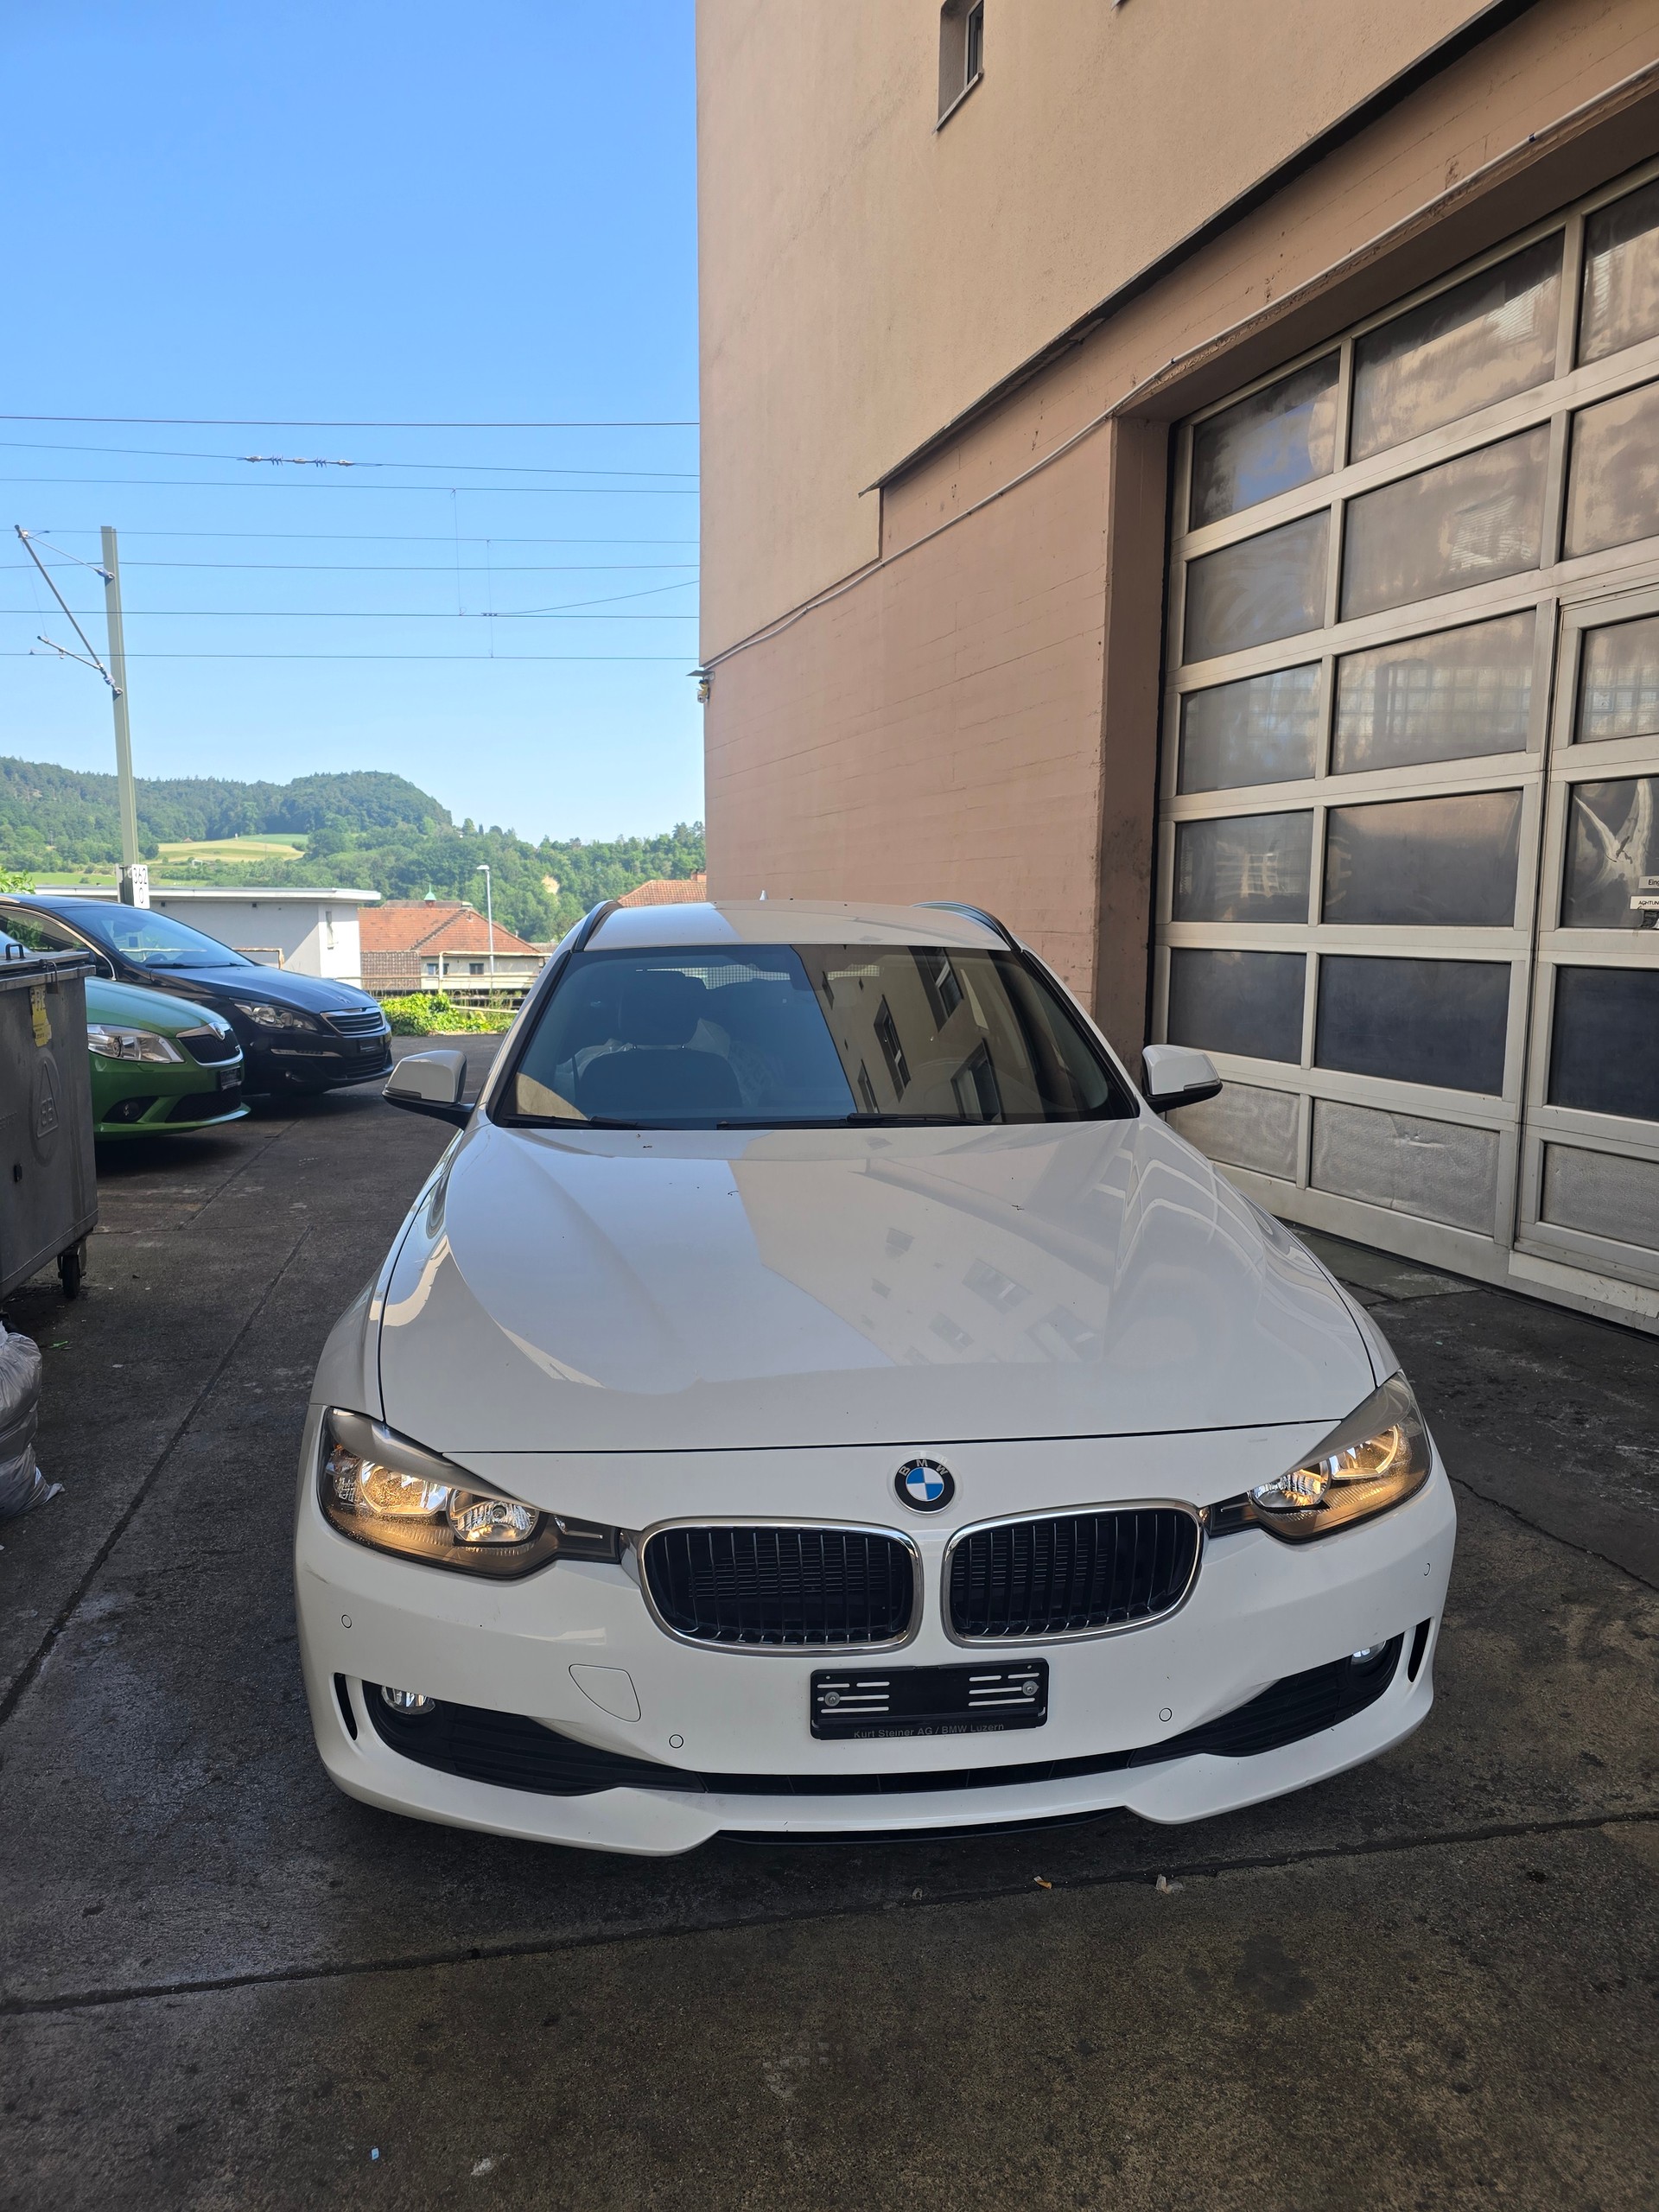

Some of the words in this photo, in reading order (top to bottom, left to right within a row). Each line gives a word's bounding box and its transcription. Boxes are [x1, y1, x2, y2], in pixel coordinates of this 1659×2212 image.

[133, 868, 148, 884] 362
[138, 887, 144, 904] 0
[899, 1459, 949, 1477] BMW
[854, 1730, 875, 1738] Kurt
[878, 1728, 915, 1738] Steiner
[917, 1726, 933, 1736] AG
[935, 1726, 940, 1735] /
[941, 1725, 968, 1734] BMW
[970, 1723, 1004, 1732] Luzern
